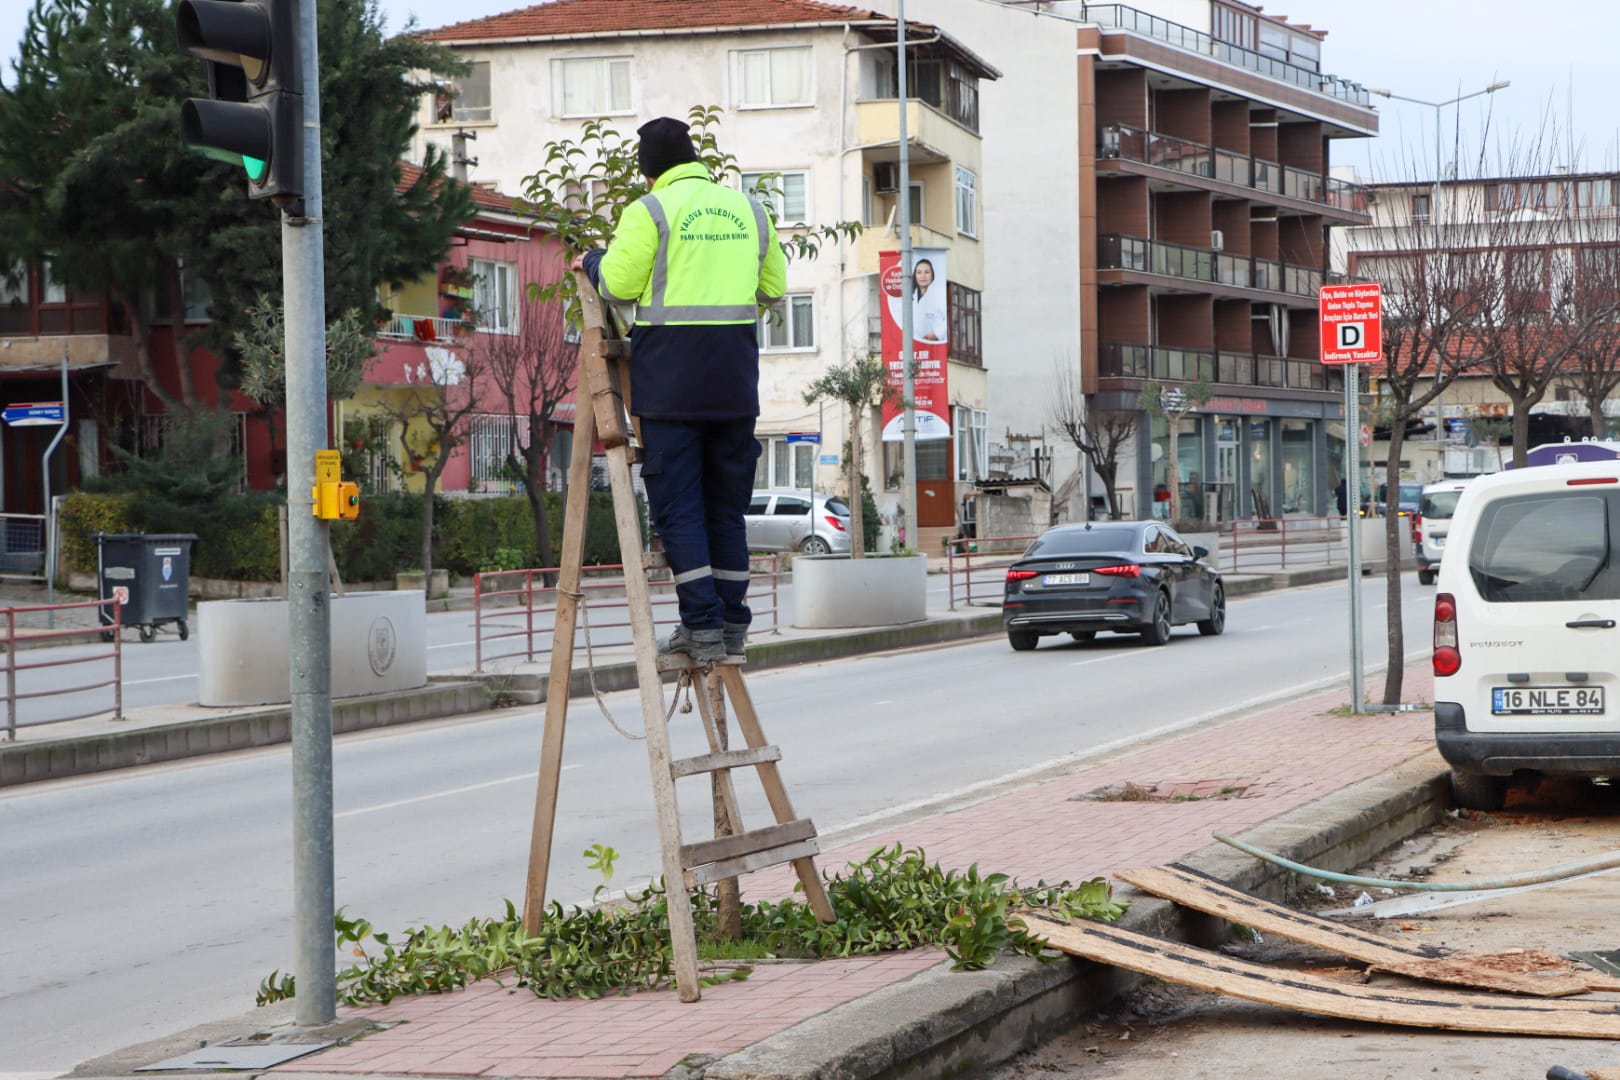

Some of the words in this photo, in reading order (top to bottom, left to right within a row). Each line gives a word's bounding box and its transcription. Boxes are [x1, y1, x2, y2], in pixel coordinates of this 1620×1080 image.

[680, 210, 702, 232] YALOVA
[1342, 326, 1360, 346] D
[1470, 640, 1524, 648] PEUGEOT
[1504, 690, 1522, 708] 16
[1529, 690, 1570, 708] NLE
[1576, 690, 1600, 707] 84
